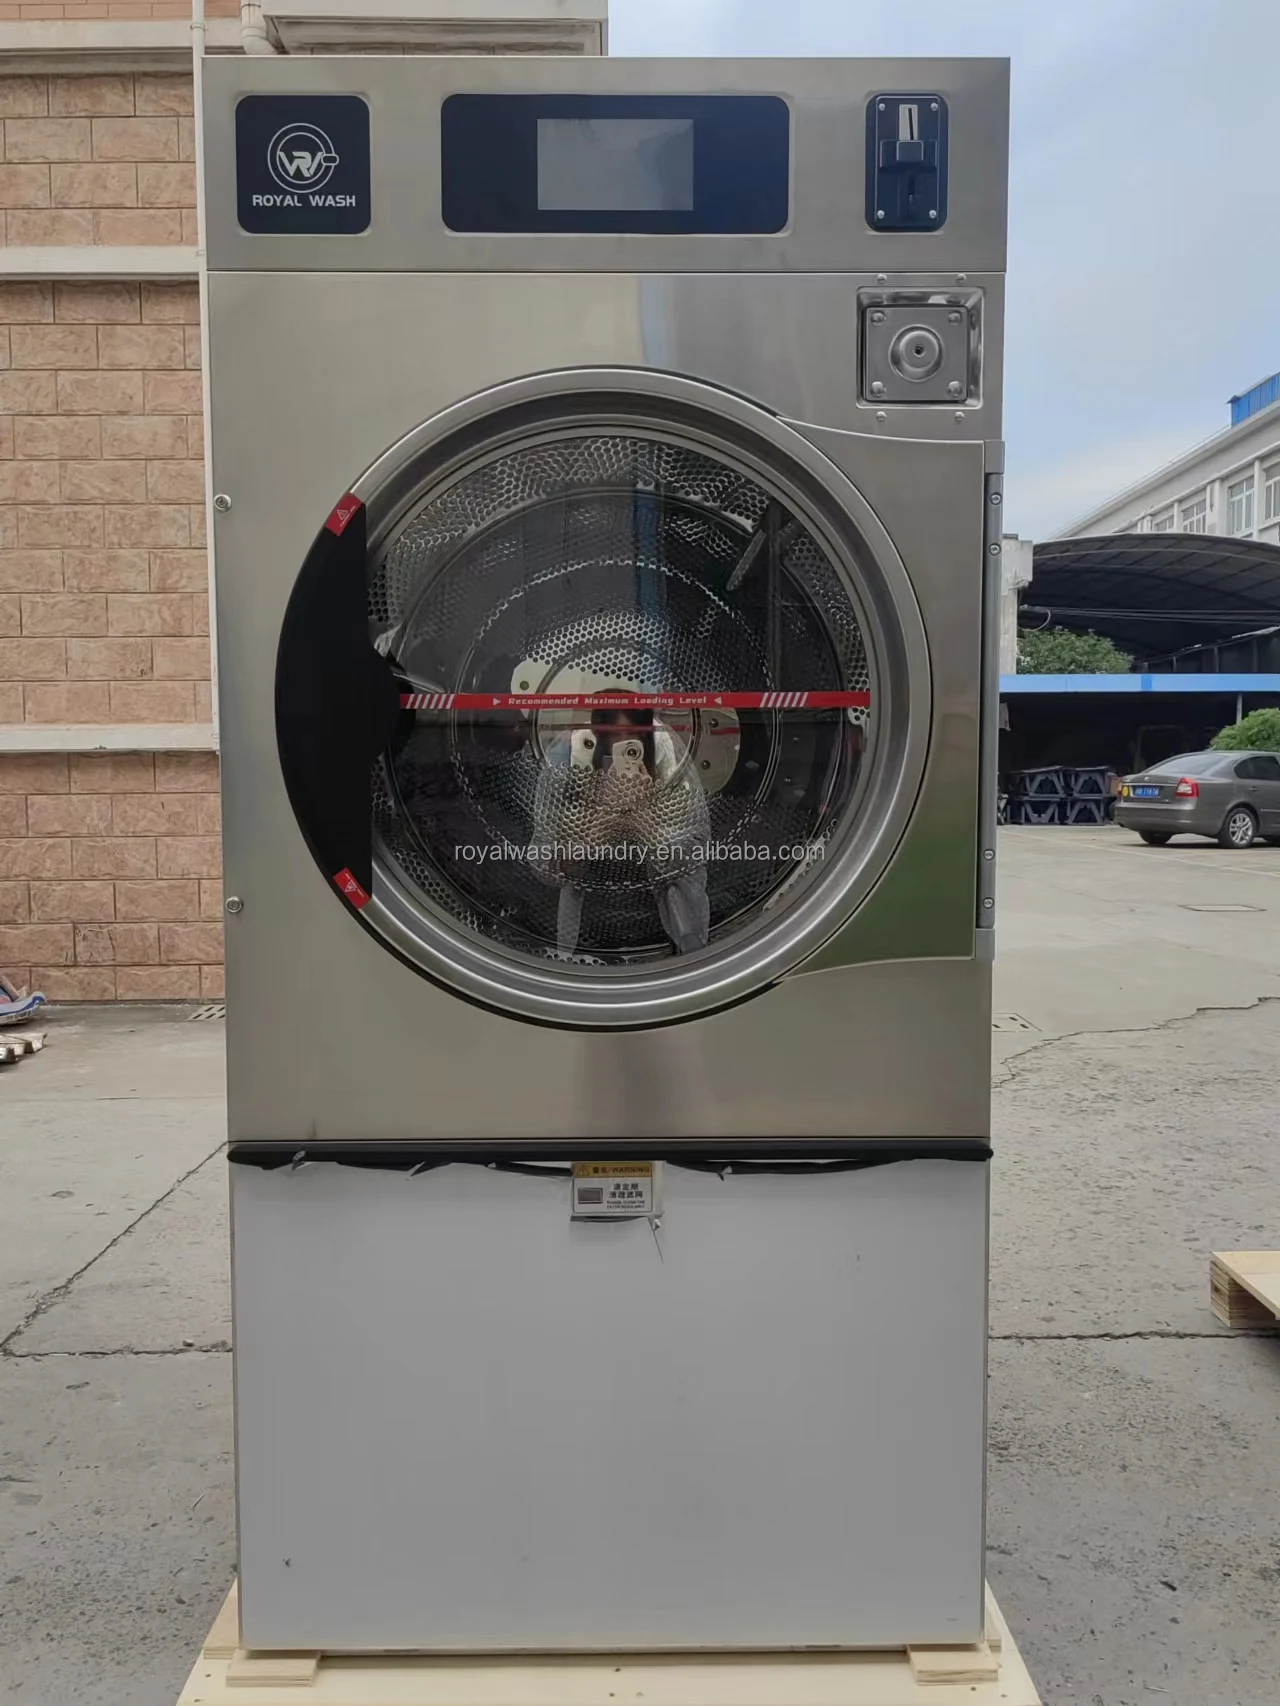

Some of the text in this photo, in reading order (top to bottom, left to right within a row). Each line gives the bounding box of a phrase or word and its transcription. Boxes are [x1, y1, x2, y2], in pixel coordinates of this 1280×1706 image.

[252, 194, 357, 207] ROYAL WASH
[508, 696, 707, 706] Recommended Maximum Loading Level
